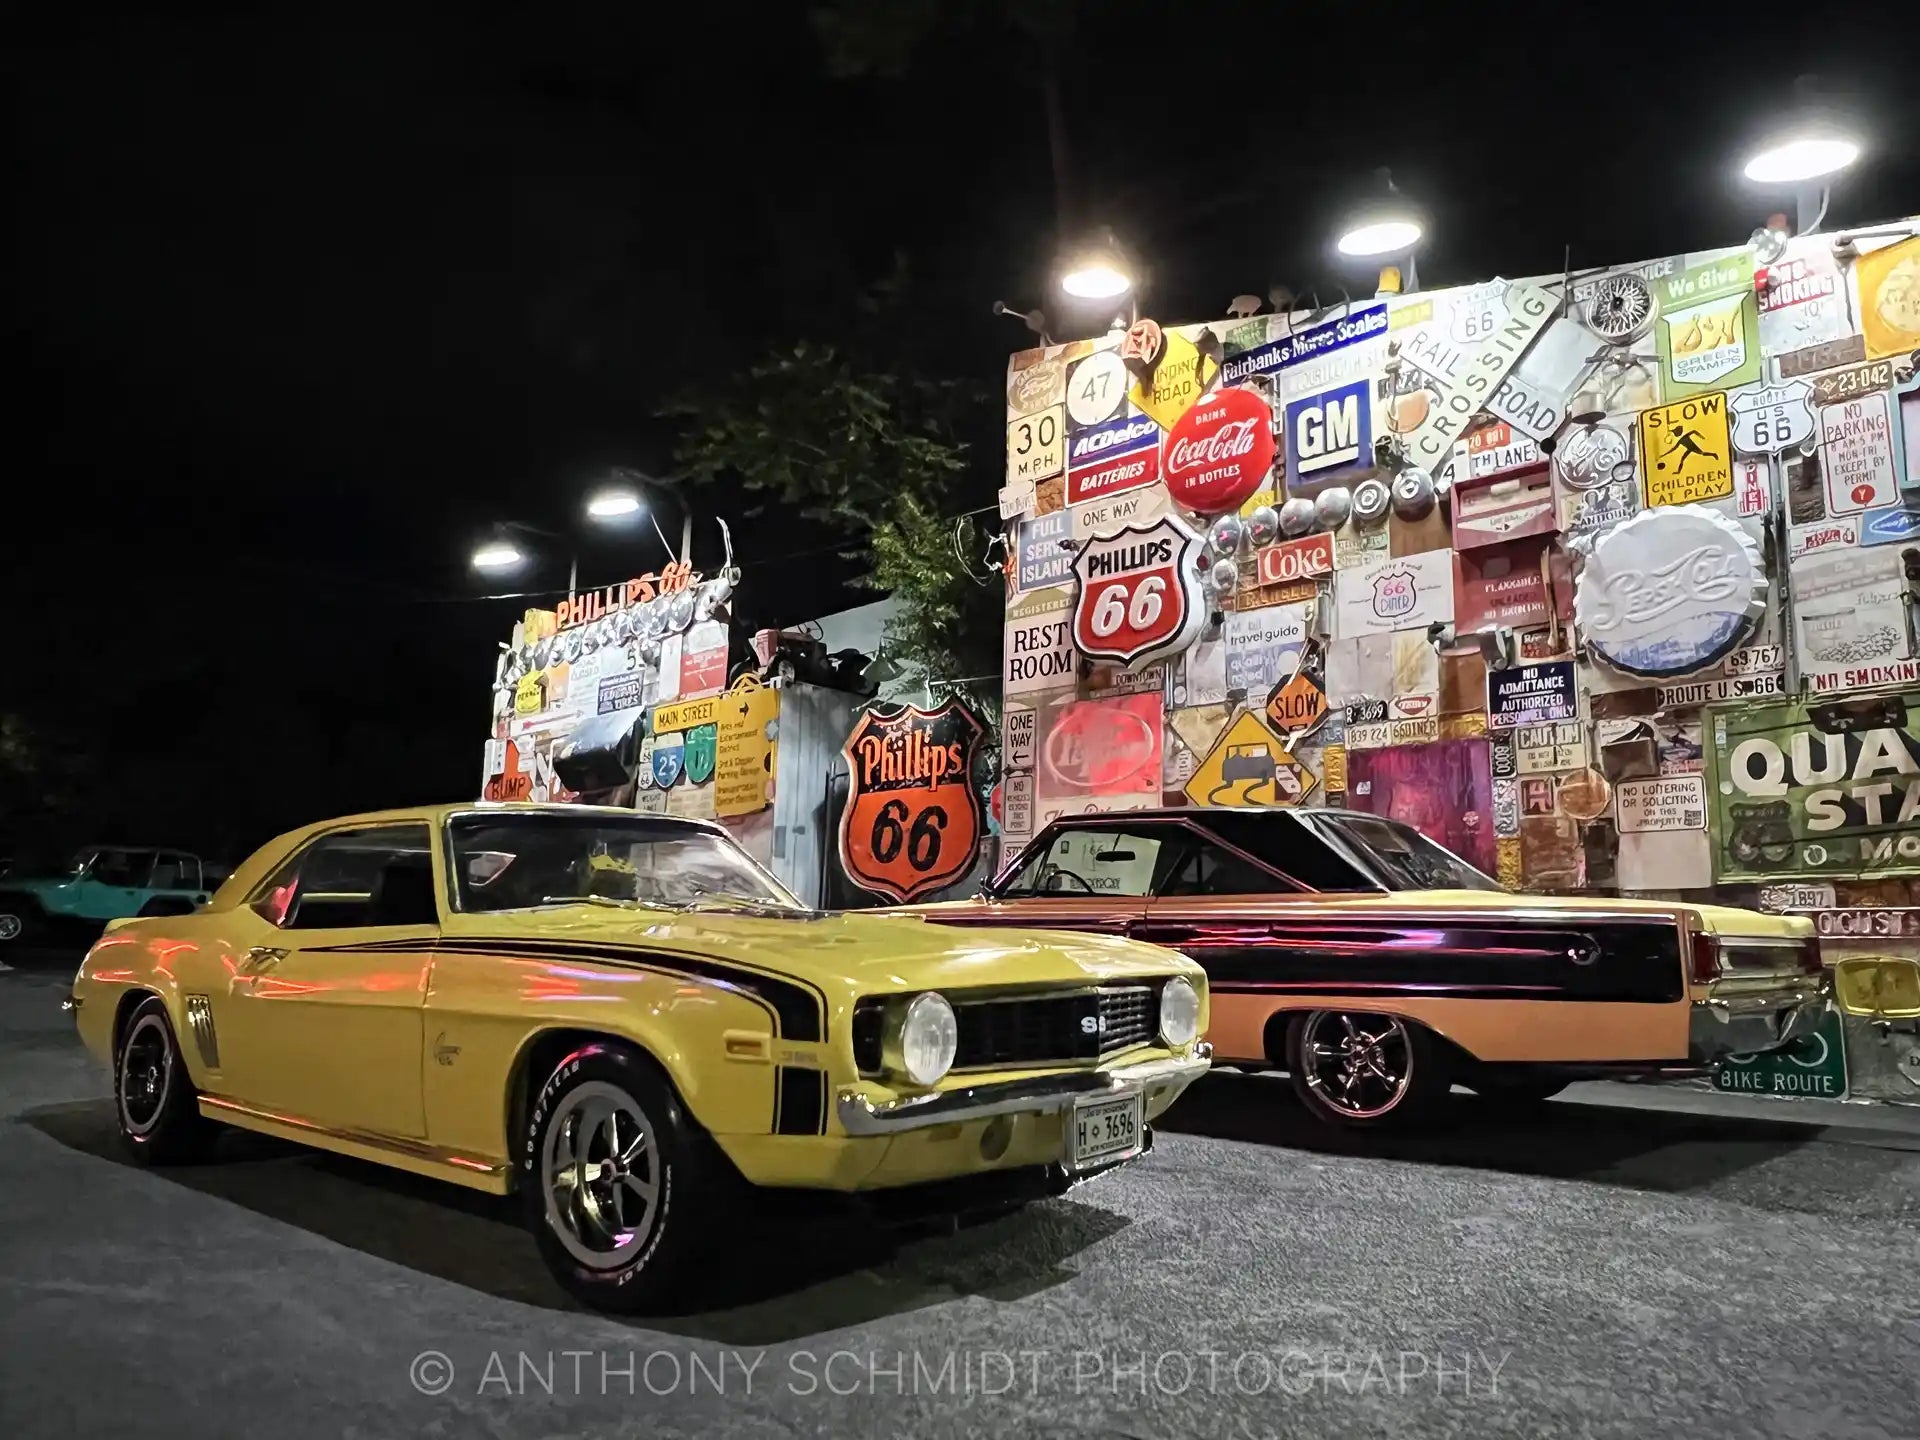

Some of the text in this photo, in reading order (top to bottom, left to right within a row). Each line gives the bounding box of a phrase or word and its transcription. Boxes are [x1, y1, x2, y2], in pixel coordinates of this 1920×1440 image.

[1668, 267, 1739, 298] We Give
[1336, 311, 1388, 343] Scales
[1465, 311, 1493, 337] 66
[1154, 355, 1200, 385] INDING
[1677, 347, 1740, 371] GREEN
[1677, 356, 1741, 379] STAMPS
[1081, 371, 1112, 404] 47
[1408, 331, 1461, 378] RAIL
[1497, 383, 1557, 432] ROAD
[1419, 297, 1546, 455] CROSSING
[1153, 380, 1192, 406] ROAD
[1752, 389, 1787, 407] ROUTE
[1195, 408, 1227, 426] DRINK
[1648, 396, 1721, 428] SLOW
[1844, 402, 1862, 420] NO
[1016, 415, 1056, 455] 30
[1073, 420, 1158, 458] ACDelco
[1297, 395, 1358, 459] GM
[1753, 419, 1792, 447] 66
[1826, 414, 1885, 441] PARKING
[1168, 417, 1259, 475] Coca-Cola
[1471, 454, 1491, 468] TH
[1495, 445, 1533, 468] LANE
[1018, 454, 1057, 476] M.P.H.
[1080, 460, 1146, 492] BATTERIES
[1185, 464, 1241, 489] IN BOTTLES
[1834, 455, 1885, 476] EXCEPT BY
[1844, 469, 1877, 486] PERMIT
[1651, 468, 1727, 493] CHILDREN
[1657, 482, 1725, 505] AT PLAY
[1083, 499, 1139, 527] ONE WAY
[1031, 518, 1064, 540] FULL
[1026, 541, 1070, 562] SERV
[1088, 537, 1172, 578] PHILLIPS
[1263, 546, 1327, 581] Coke
[1021, 558, 1073, 584] ISLAND
[556, 559, 692, 629] PHILLIPS 66
[1383, 581, 1405, 597] 66
[1091, 575, 1167, 637] 66
[1014, 621, 1068, 654] REST
[1231, 625, 1299, 646] travel guide
[1009, 648, 1073, 682] ROOM
[1115, 668, 1162, 686] DOWNTOWN
[1522, 667, 1539, 680] NO
[1499, 675, 1565, 695] ADMITTANCE
[1666, 684, 1713, 705] ROUTE
[1755, 676, 1775, 695] 66
[1816, 673, 1839, 690] NO
[659, 702, 714, 728] MAIN STREET
[1275, 692, 1320, 720] SLOW
[1501, 693, 1564, 712] AUTHORIZED
[1009, 714, 1033, 732] ONE
[1491, 704, 1575, 727] PERSONNEL ONLY
[1009, 732, 1033, 748] WAY
[1392, 720, 1437, 743] 66DINER
[658, 754, 677, 777] 25
[858, 729, 966, 792] Phillips
[491, 777, 526, 800] BUMP
[1013, 780, 1025, 792] NO
[1623, 782, 1696, 797] NO LOITERING
[1622, 794, 1698, 808] OR SOLICITING
[1643, 808, 1677, 817] ON THIS
[871, 799, 948, 872] 66
[1817, 911, 1908, 935] OCUST
[1721, 1070, 1835, 1094] BIKE ROUTE
[1078, 1111, 1134, 1147] H 3696
